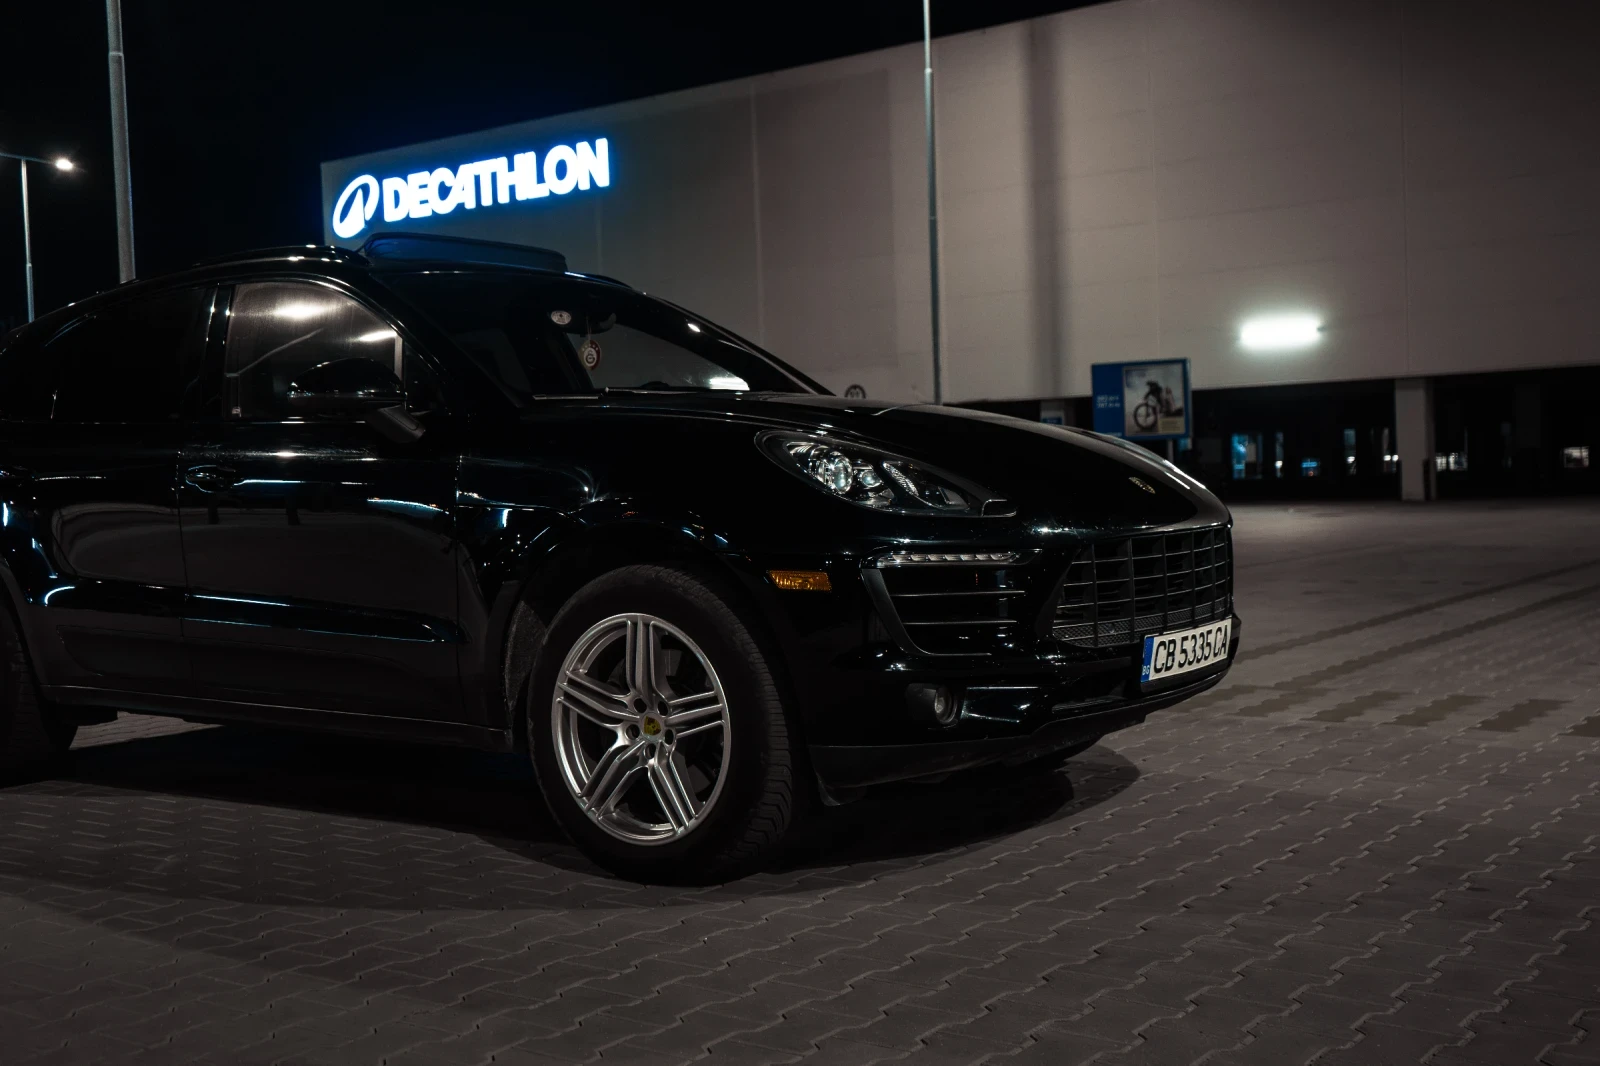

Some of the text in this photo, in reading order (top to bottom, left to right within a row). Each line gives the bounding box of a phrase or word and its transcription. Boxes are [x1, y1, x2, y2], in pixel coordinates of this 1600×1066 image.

[382, 137, 610, 222] DECATHLON
[1141, 664, 1151, 676] BG
[1154, 625, 1228, 673] CB 5335 CA
